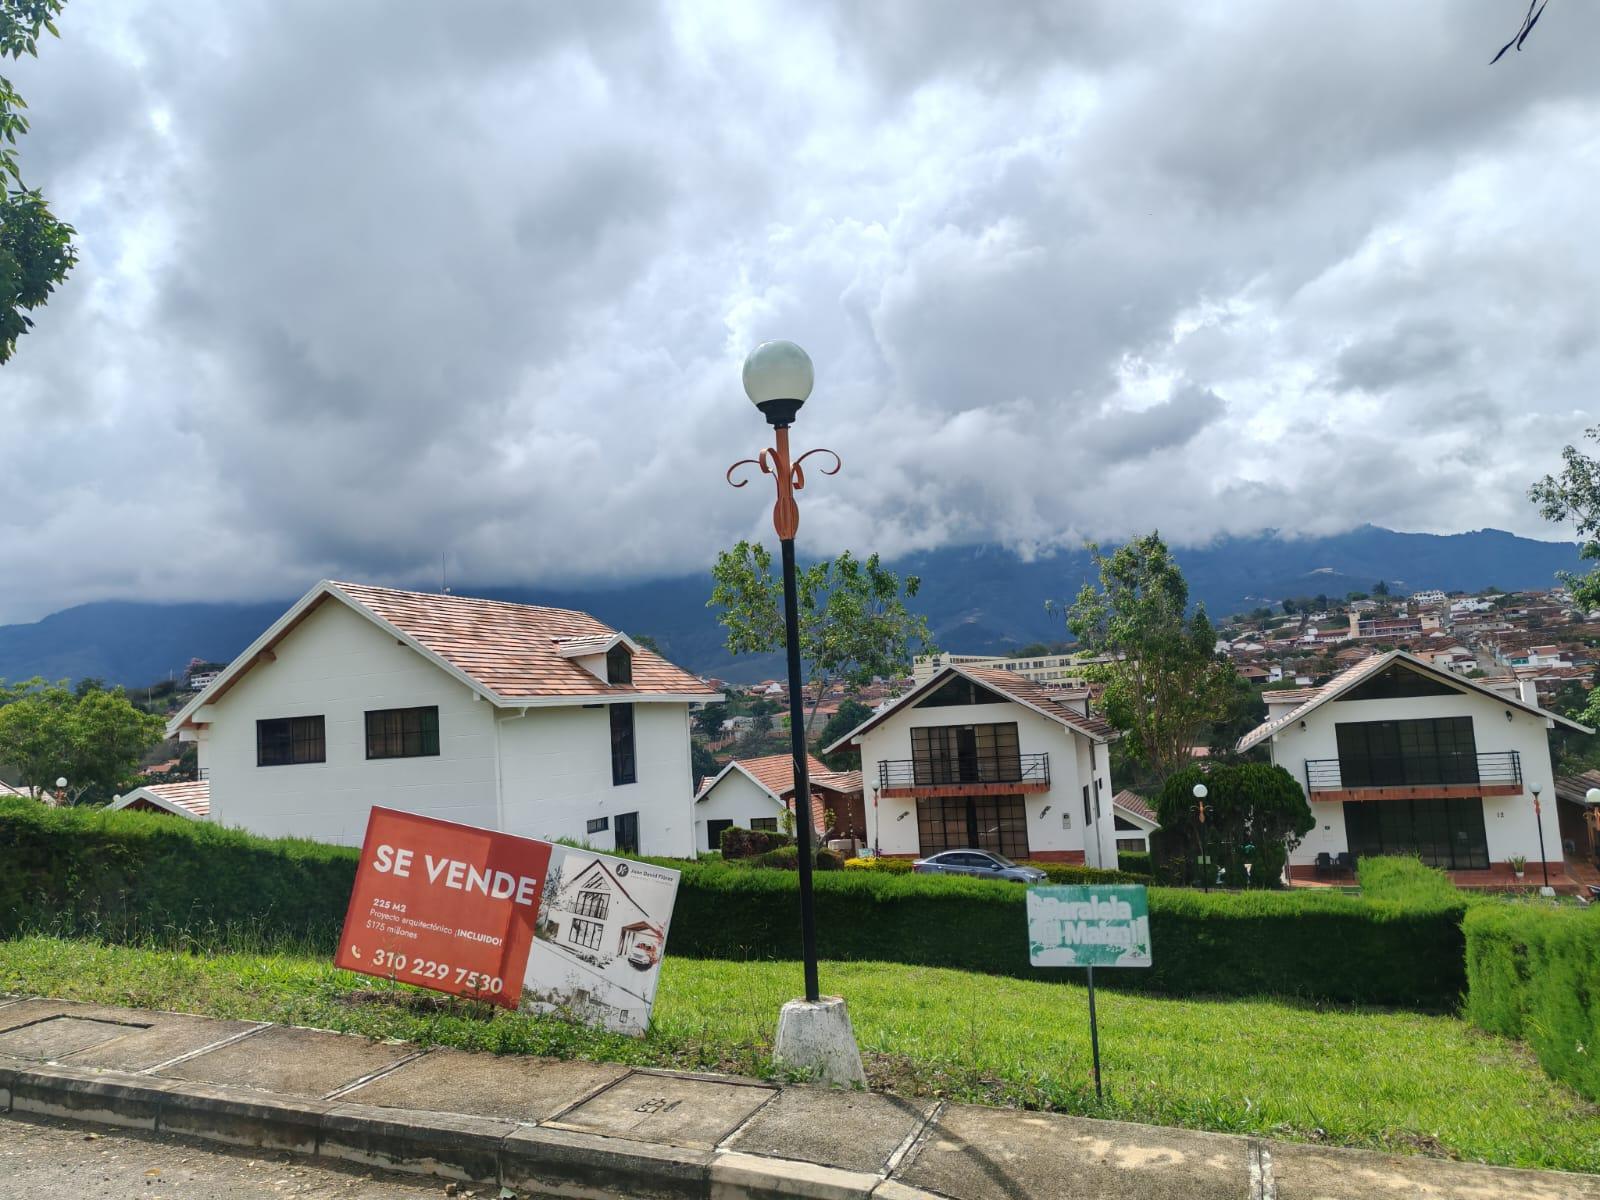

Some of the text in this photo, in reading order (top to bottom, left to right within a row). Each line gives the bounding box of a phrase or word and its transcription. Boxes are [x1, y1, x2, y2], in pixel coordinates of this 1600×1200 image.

[373, 844, 537, 906] SE VENDE
[643, 871, 658, 879] David
[373, 898, 407, 913] 225 M2
[366, 920, 418, 940] $175 millones
[370, 908, 503, 947] Proyecto arquitectónico ¡INCLUIDO!
[372, 949, 503, 994] 310 229 7530
